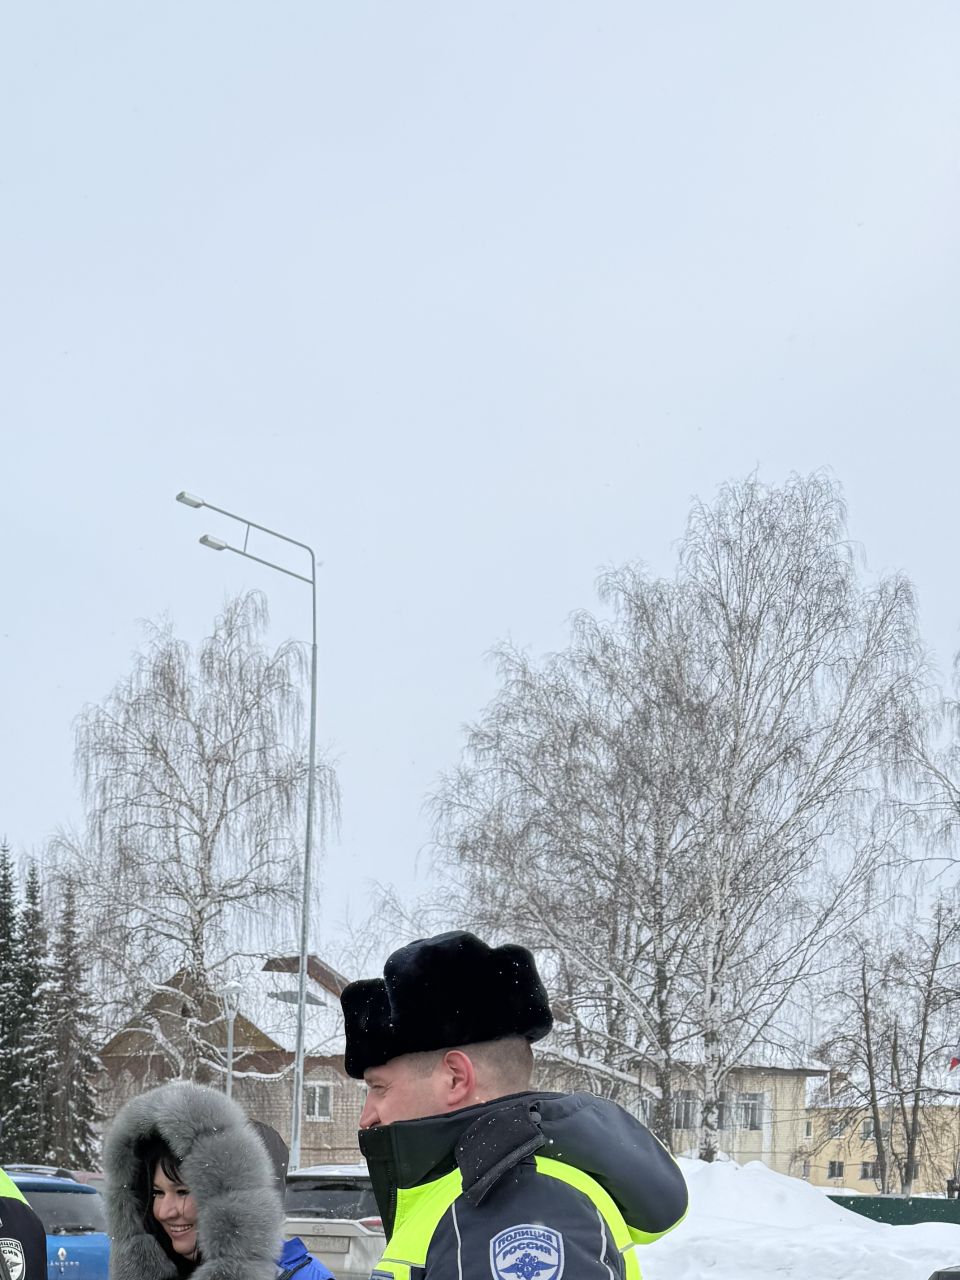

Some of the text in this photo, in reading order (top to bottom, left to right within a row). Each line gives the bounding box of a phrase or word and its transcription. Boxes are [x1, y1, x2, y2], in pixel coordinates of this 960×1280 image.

[497, 1230, 552, 1249] ПОЛИЦИЯ
[2, 1249, 18, 1257] СИЯ
[502, 1242, 551, 1260] РОССИЯ
